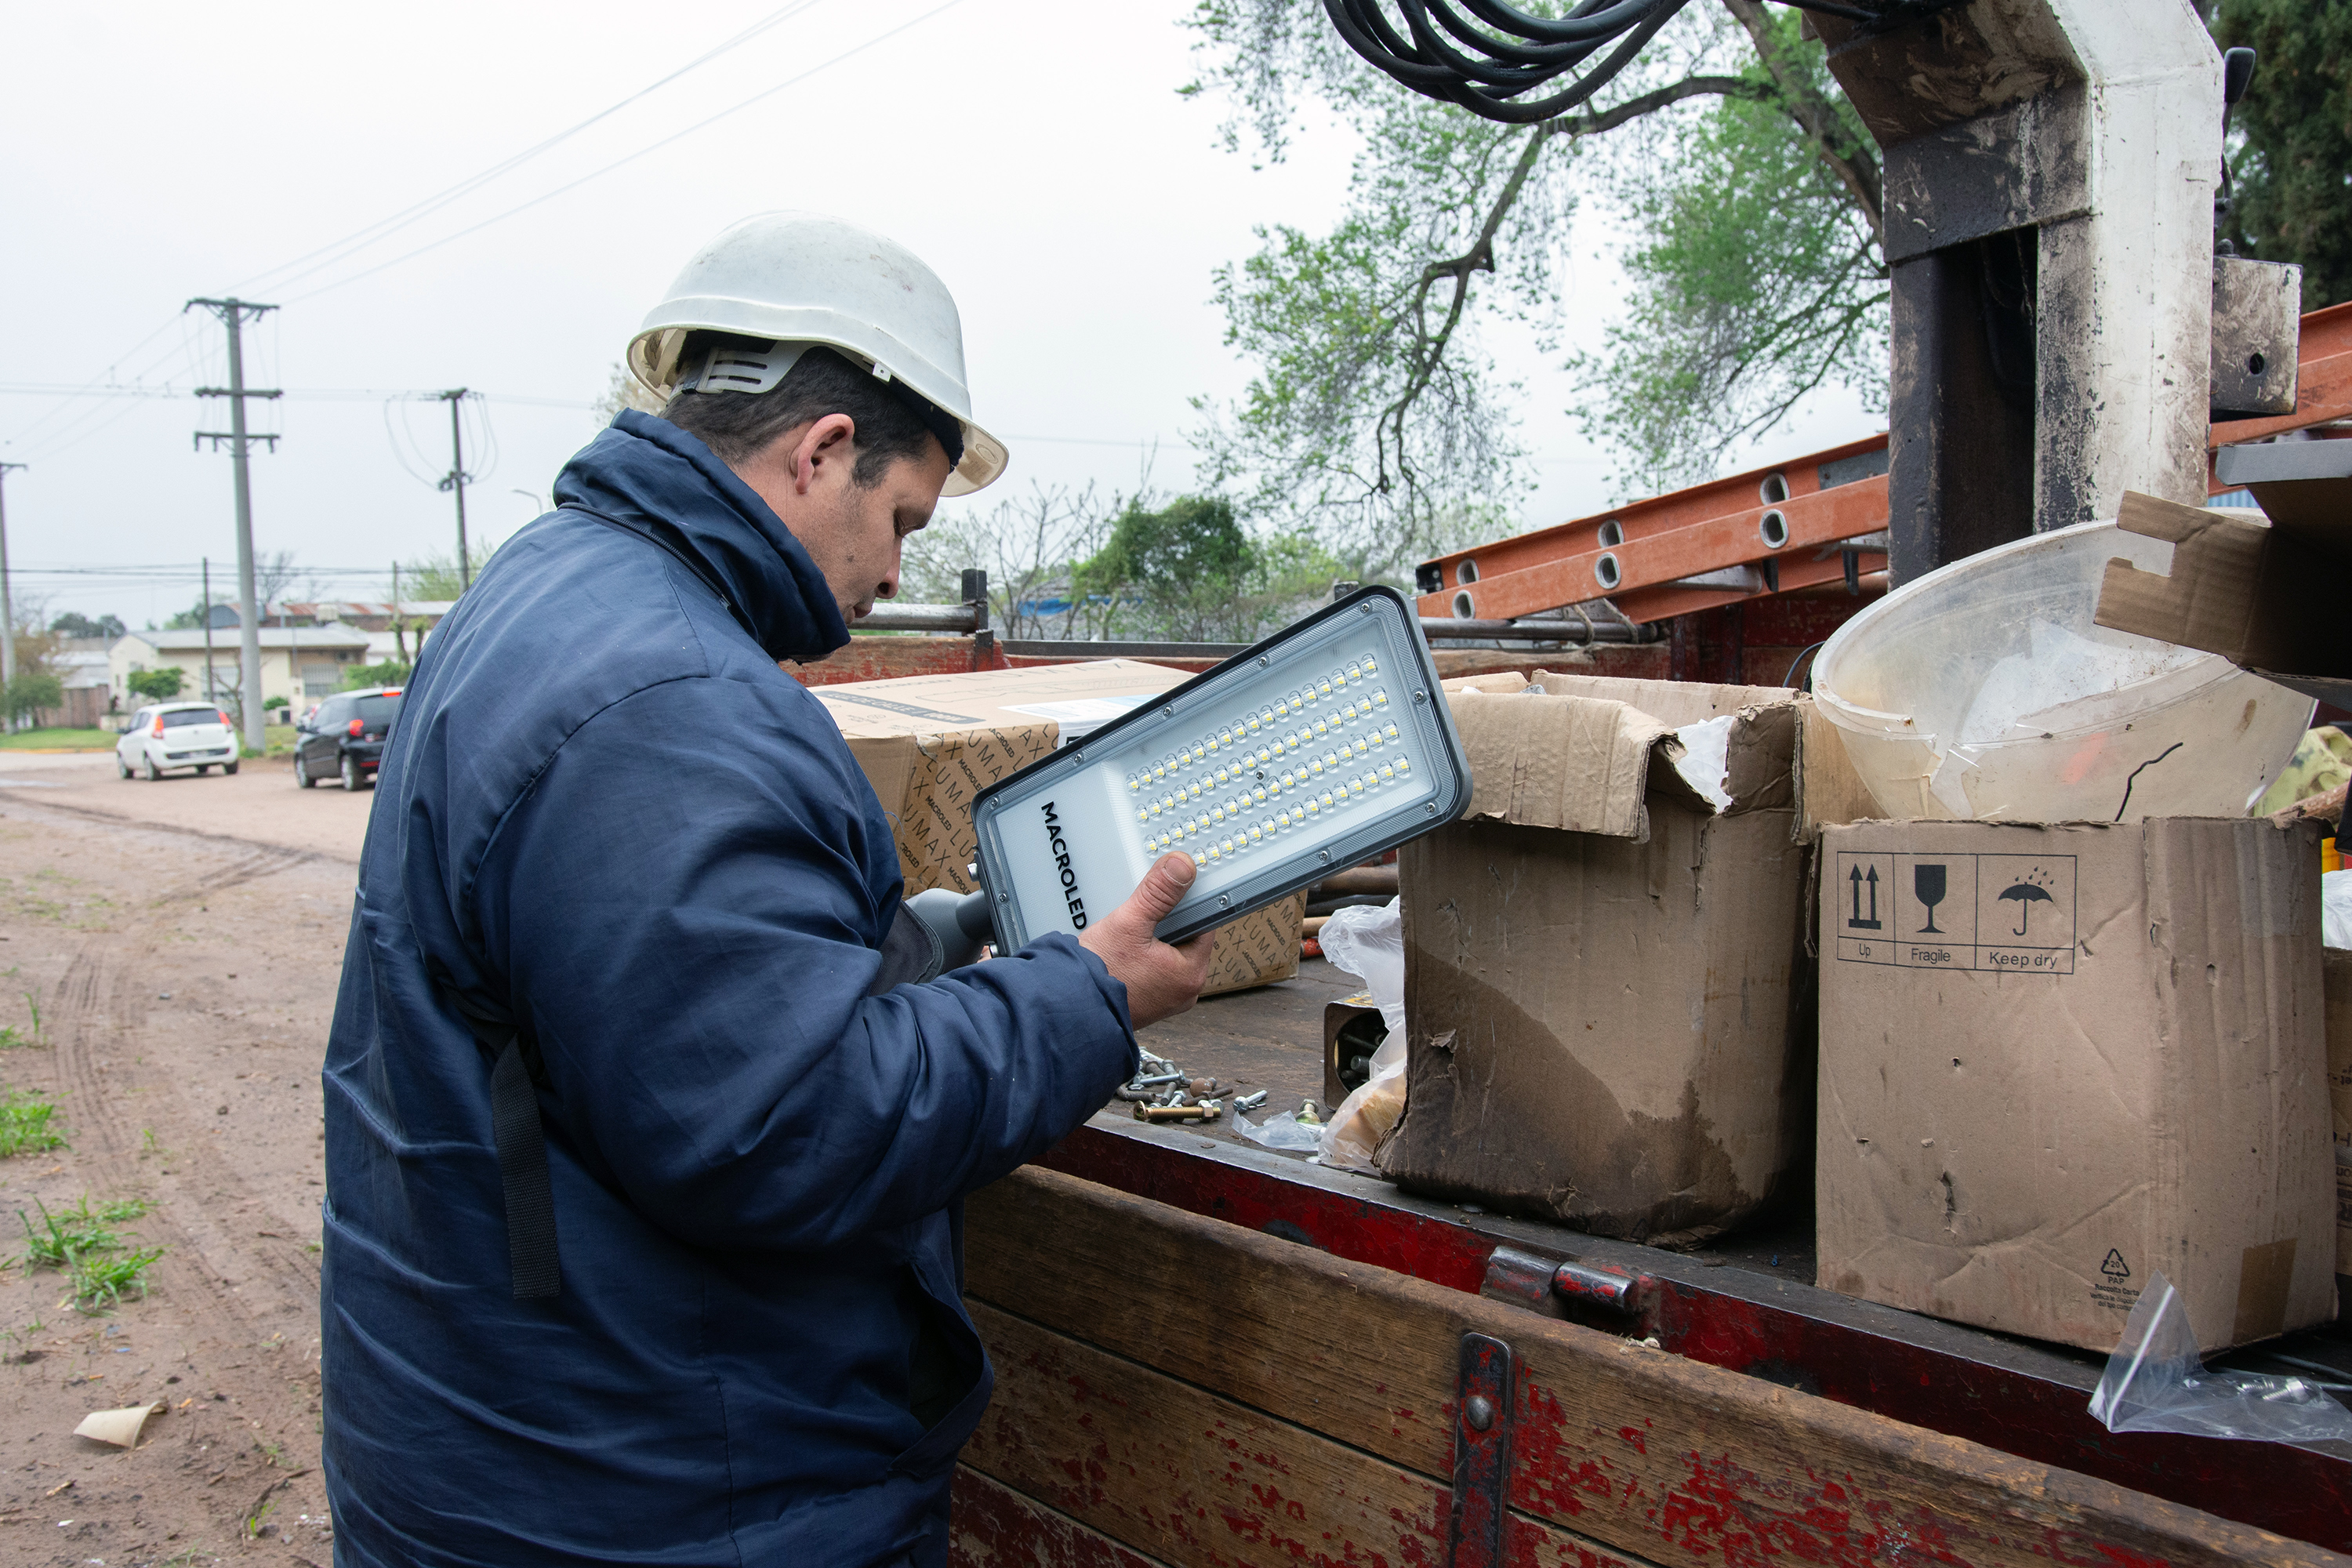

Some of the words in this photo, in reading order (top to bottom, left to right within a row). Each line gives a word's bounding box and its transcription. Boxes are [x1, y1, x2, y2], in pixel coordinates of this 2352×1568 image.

[925, 795, 952, 831] MACROLED
[1041, 801, 1087, 930] MACROLED
[1243, 915, 1284, 975] LUMAX
[1859, 943, 1871, 956] Up
[1911, 948, 1951, 964] Fragile
[1989, 951, 2030, 968] Keep
[2034, 953, 2058, 969] dry
[2108, 1276, 2125, 1285] PAP
